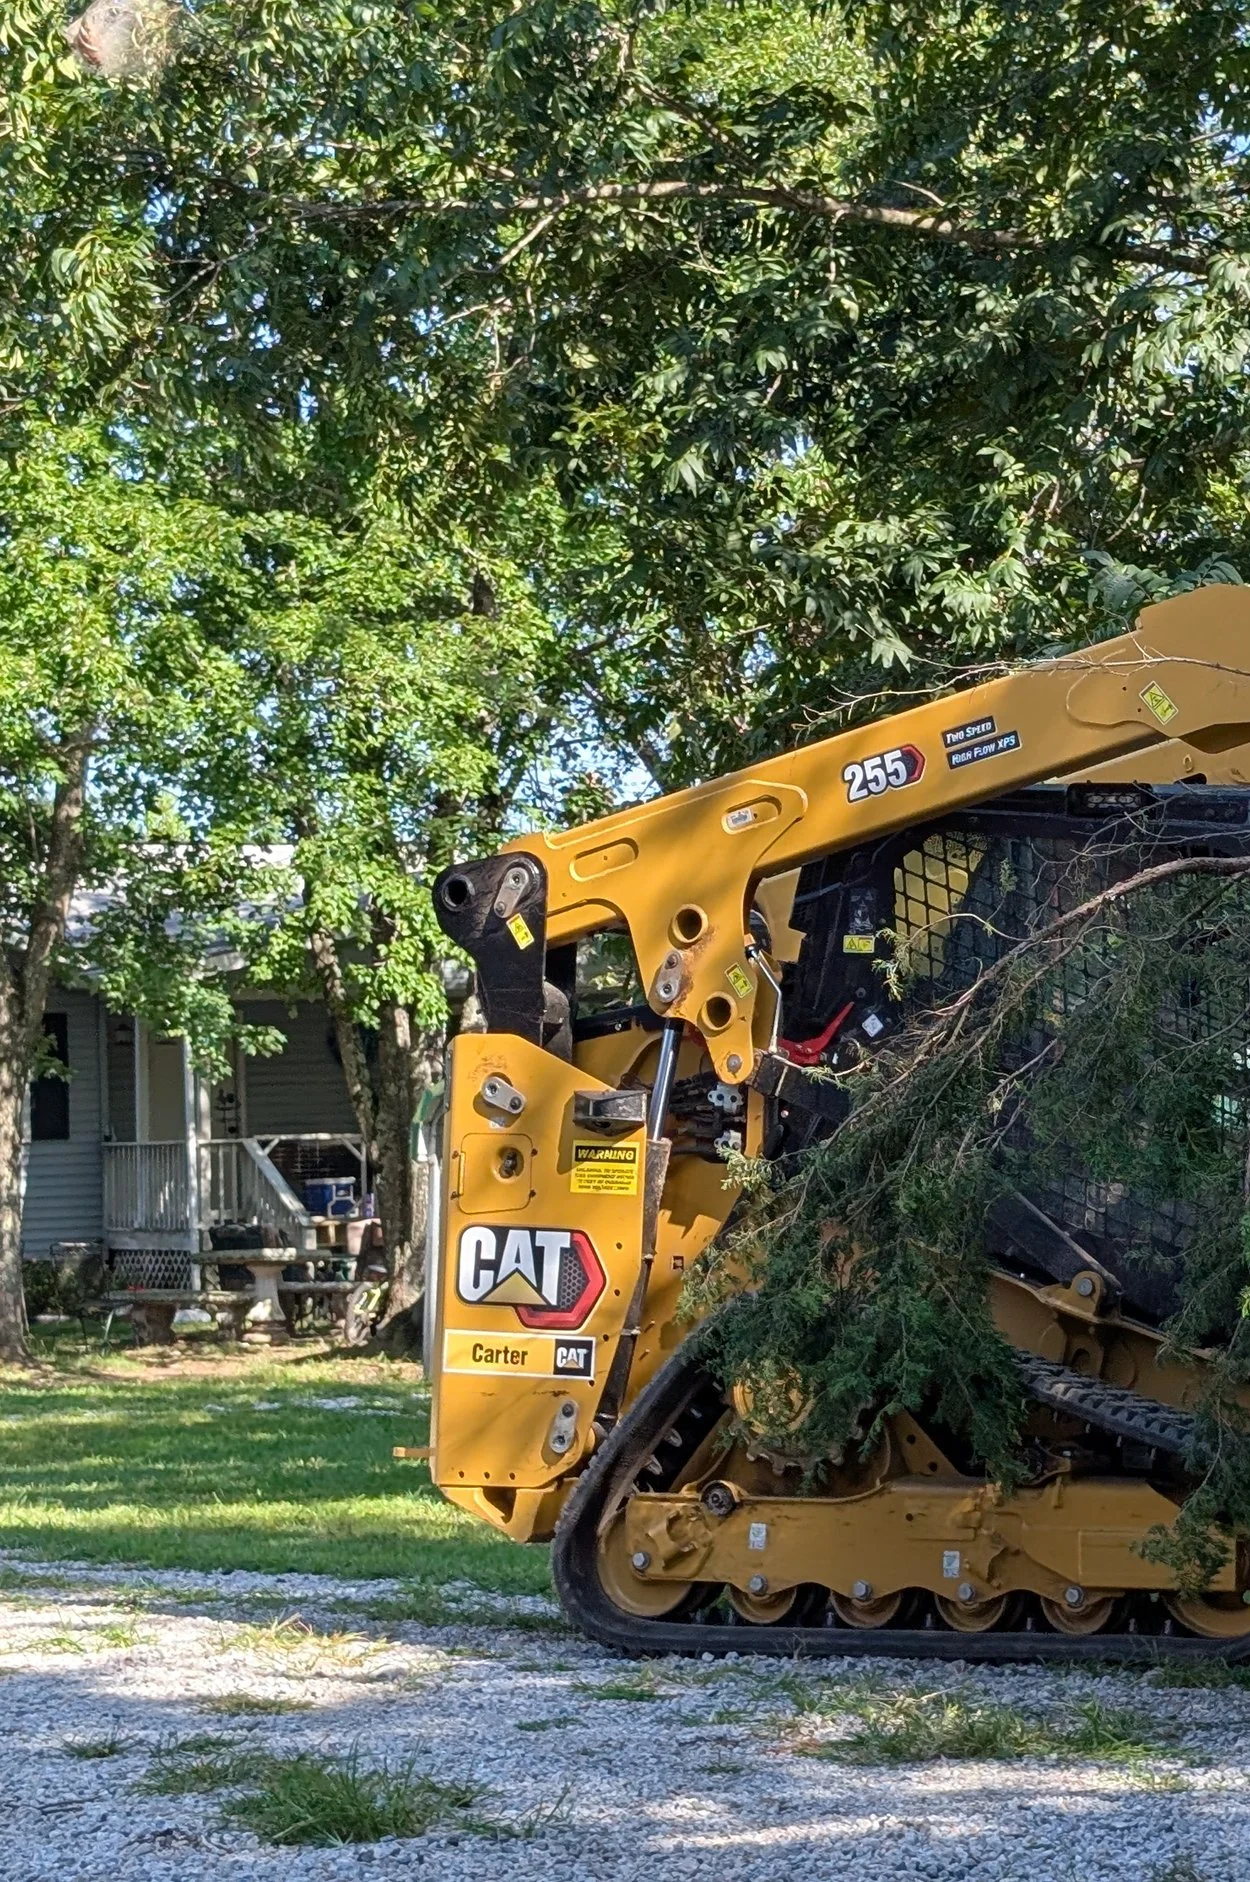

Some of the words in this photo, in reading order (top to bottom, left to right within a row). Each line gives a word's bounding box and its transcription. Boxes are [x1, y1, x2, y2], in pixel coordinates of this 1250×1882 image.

[946, 730, 965, 744] TWO
[966, 722, 992, 737] SPEED
[973, 743, 996, 758] FLOW
[997, 735, 1016, 750] XPS
[844, 750, 907, 801] 255
[577, 1148, 634, 1161] WARNING
[458, 1226, 571, 1306] CAT
[472, 1343, 528, 1366] Carter
[556, 1347, 589, 1369] CAT
